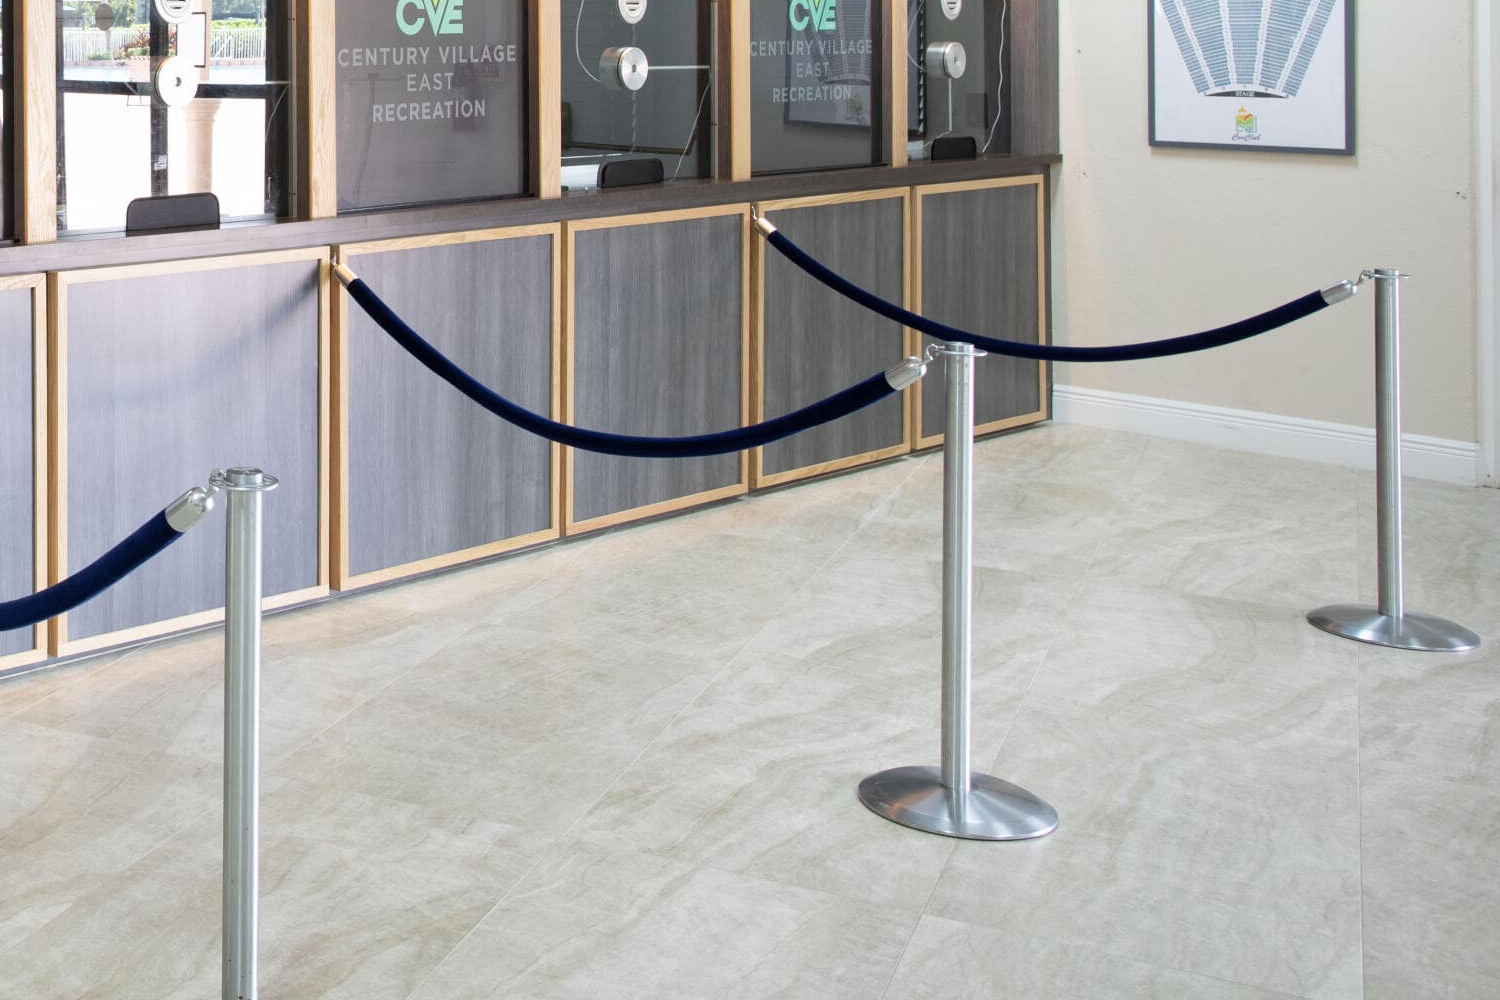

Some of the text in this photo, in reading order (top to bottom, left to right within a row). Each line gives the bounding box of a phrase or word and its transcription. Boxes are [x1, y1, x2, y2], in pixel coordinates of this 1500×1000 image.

[338, 44, 516, 67] CENTURY VILLAGE
[750, 39, 873, 57] CENTURY VILLAGE
[797, 62, 829, 78] EAST
[407, 72, 454, 92] EAST
[773, 86, 852, 103] RECREATION
[373, 100, 486, 122] RECREATION
